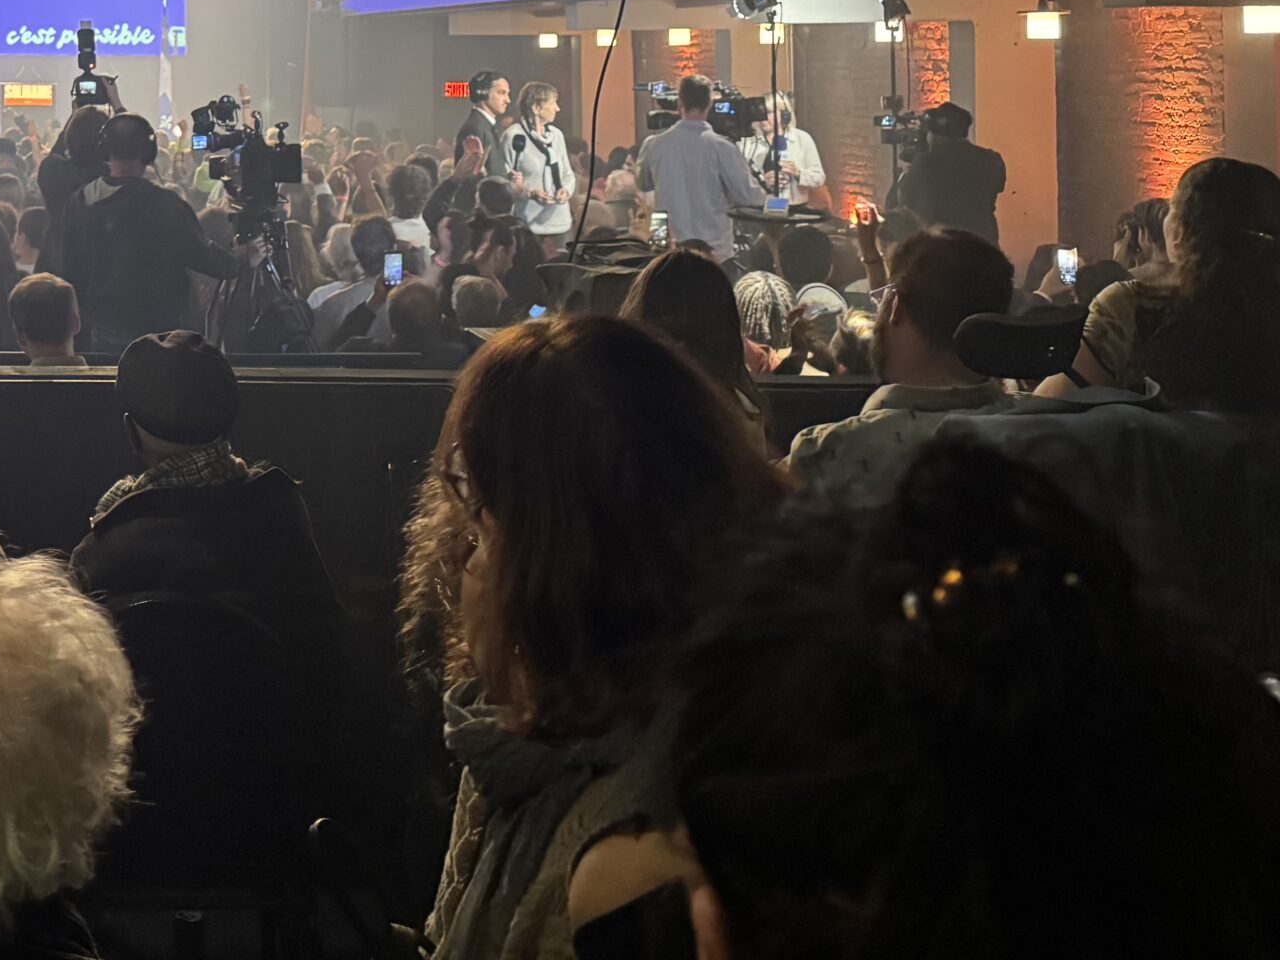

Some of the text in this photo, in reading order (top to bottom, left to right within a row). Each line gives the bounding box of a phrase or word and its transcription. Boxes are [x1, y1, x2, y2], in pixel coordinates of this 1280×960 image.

[6, 23, 155, 49] c'est pssible
[444, 82, 470, 97] SORT
